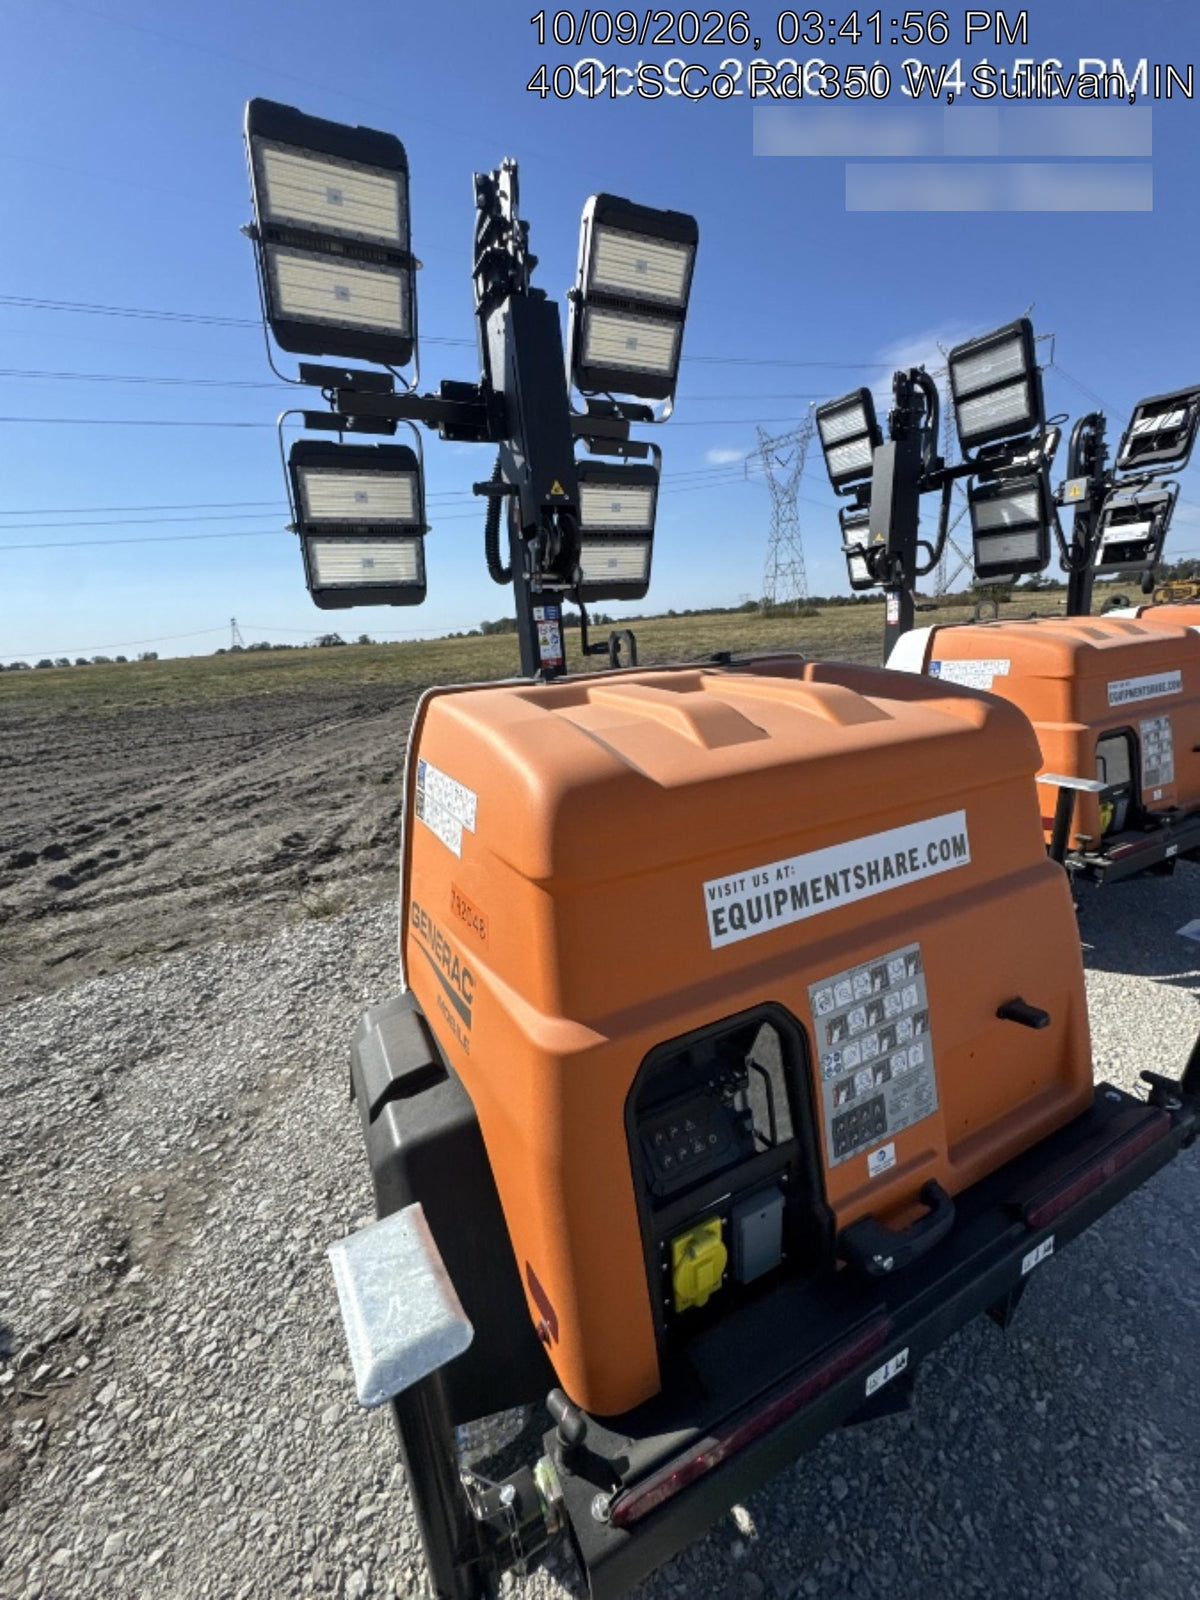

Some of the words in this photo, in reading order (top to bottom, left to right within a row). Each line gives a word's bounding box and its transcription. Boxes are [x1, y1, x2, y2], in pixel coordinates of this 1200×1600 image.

[707, 878, 746, 901] VISIT
[752, 872, 770, 889] US
[775, 864, 797, 882] AT:
[711, 832, 967, 937] EQUIPMENTSHARE.COM
[410, 901, 475, 1006] GENERAC
